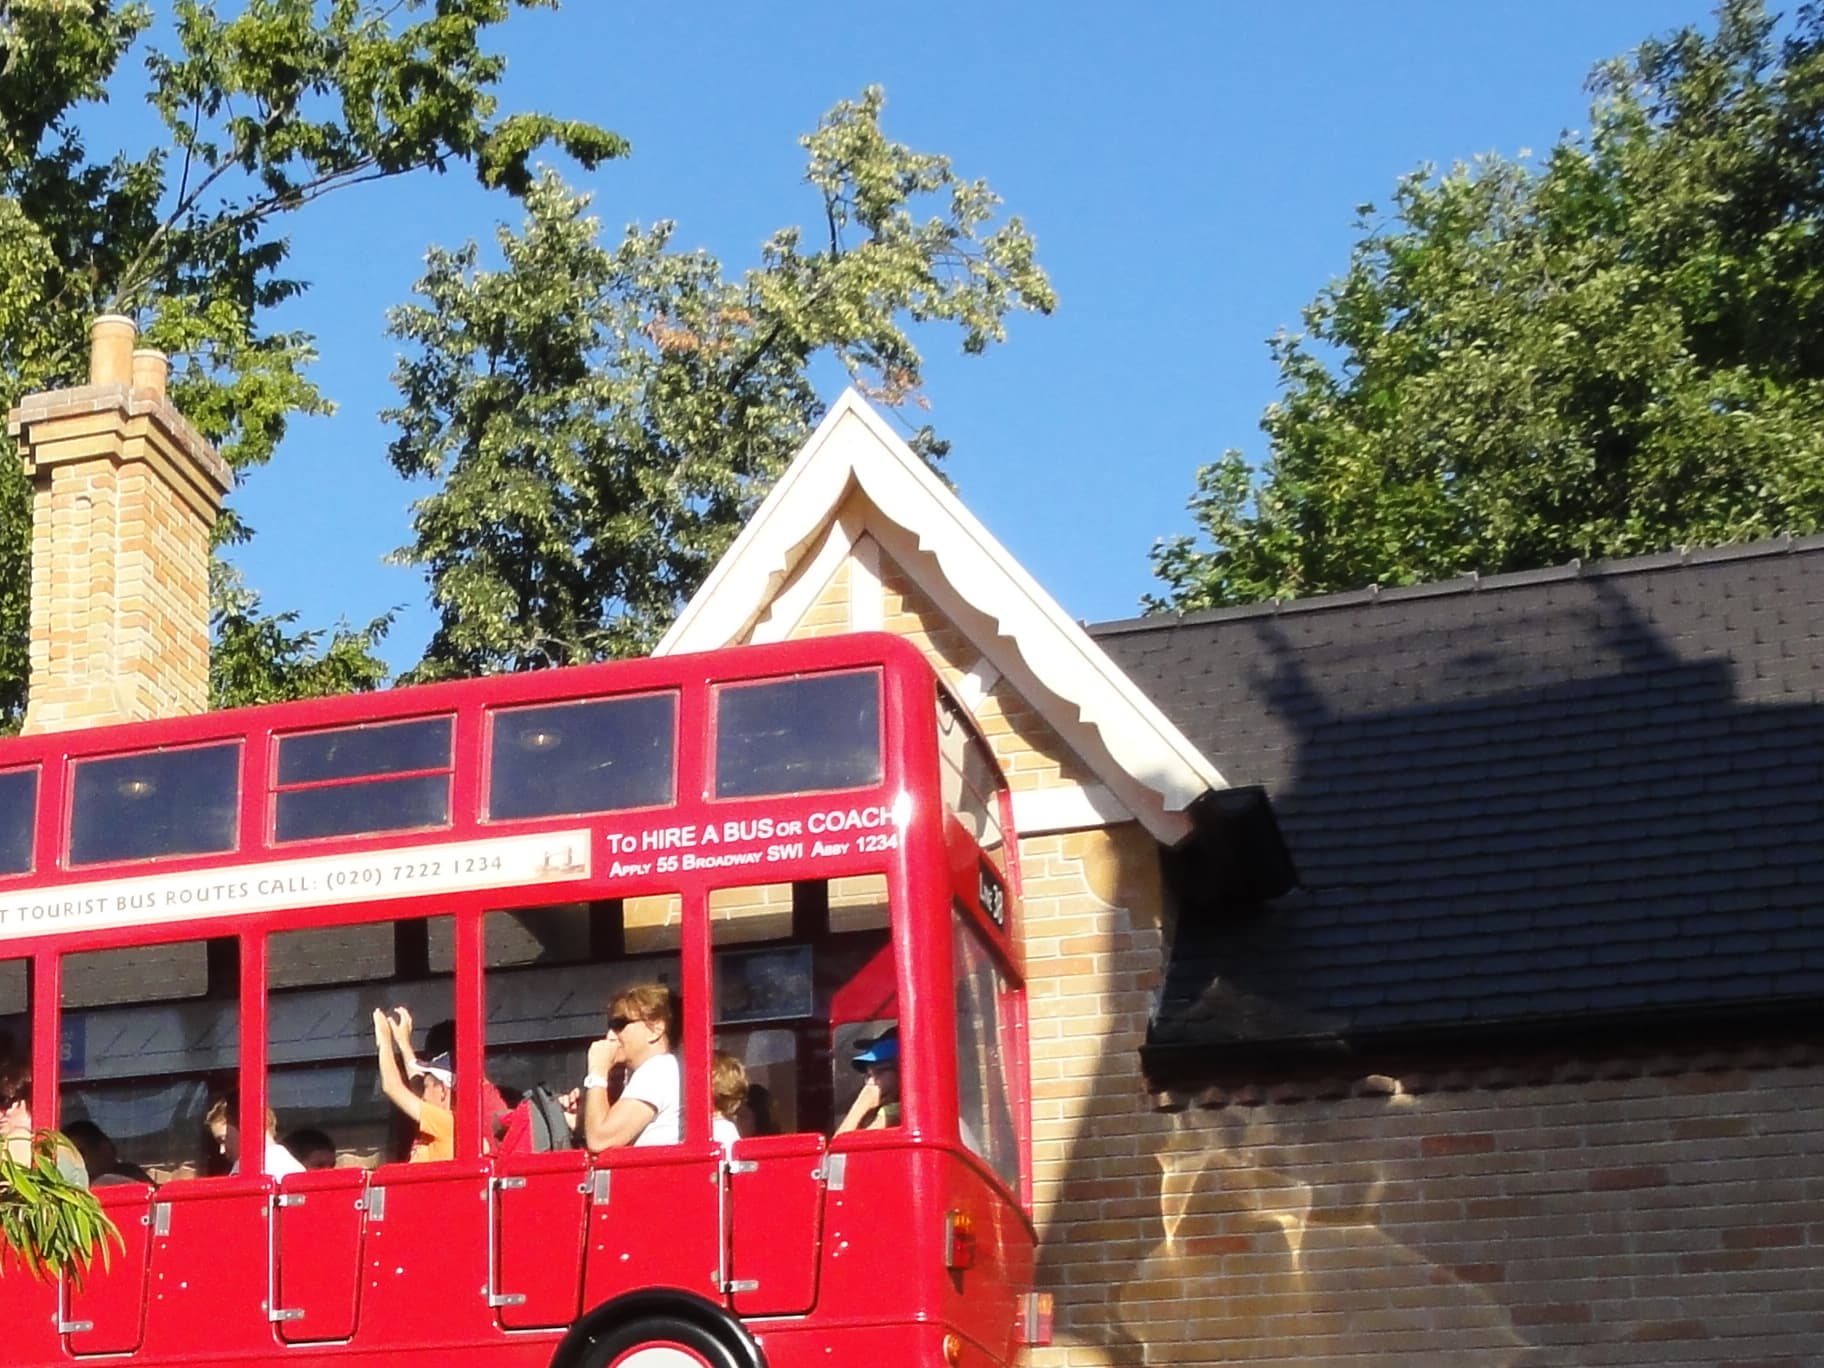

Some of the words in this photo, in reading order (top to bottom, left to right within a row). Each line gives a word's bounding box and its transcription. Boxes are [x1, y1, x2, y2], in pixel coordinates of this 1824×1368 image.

[641, 825, 696, 850] HIRE
[700, 825, 720, 846] A
[723, 817, 774, 843] BUS
[807, 805, 895, 834] COACH
[656, 854, 679, 874] 55
[854, 832, 898, 853] 1234
[17, 897, 109, 922] TOURIST
[116, 891, 156, 911] BUS
[165, 881, 250, 906] ROUTES
[257, 875, 318, 897] CALL:
[326, 866, 382, 892] (020)
[392, 861, 442, 881] 7222
[453, 855, 503, 875] 1234
